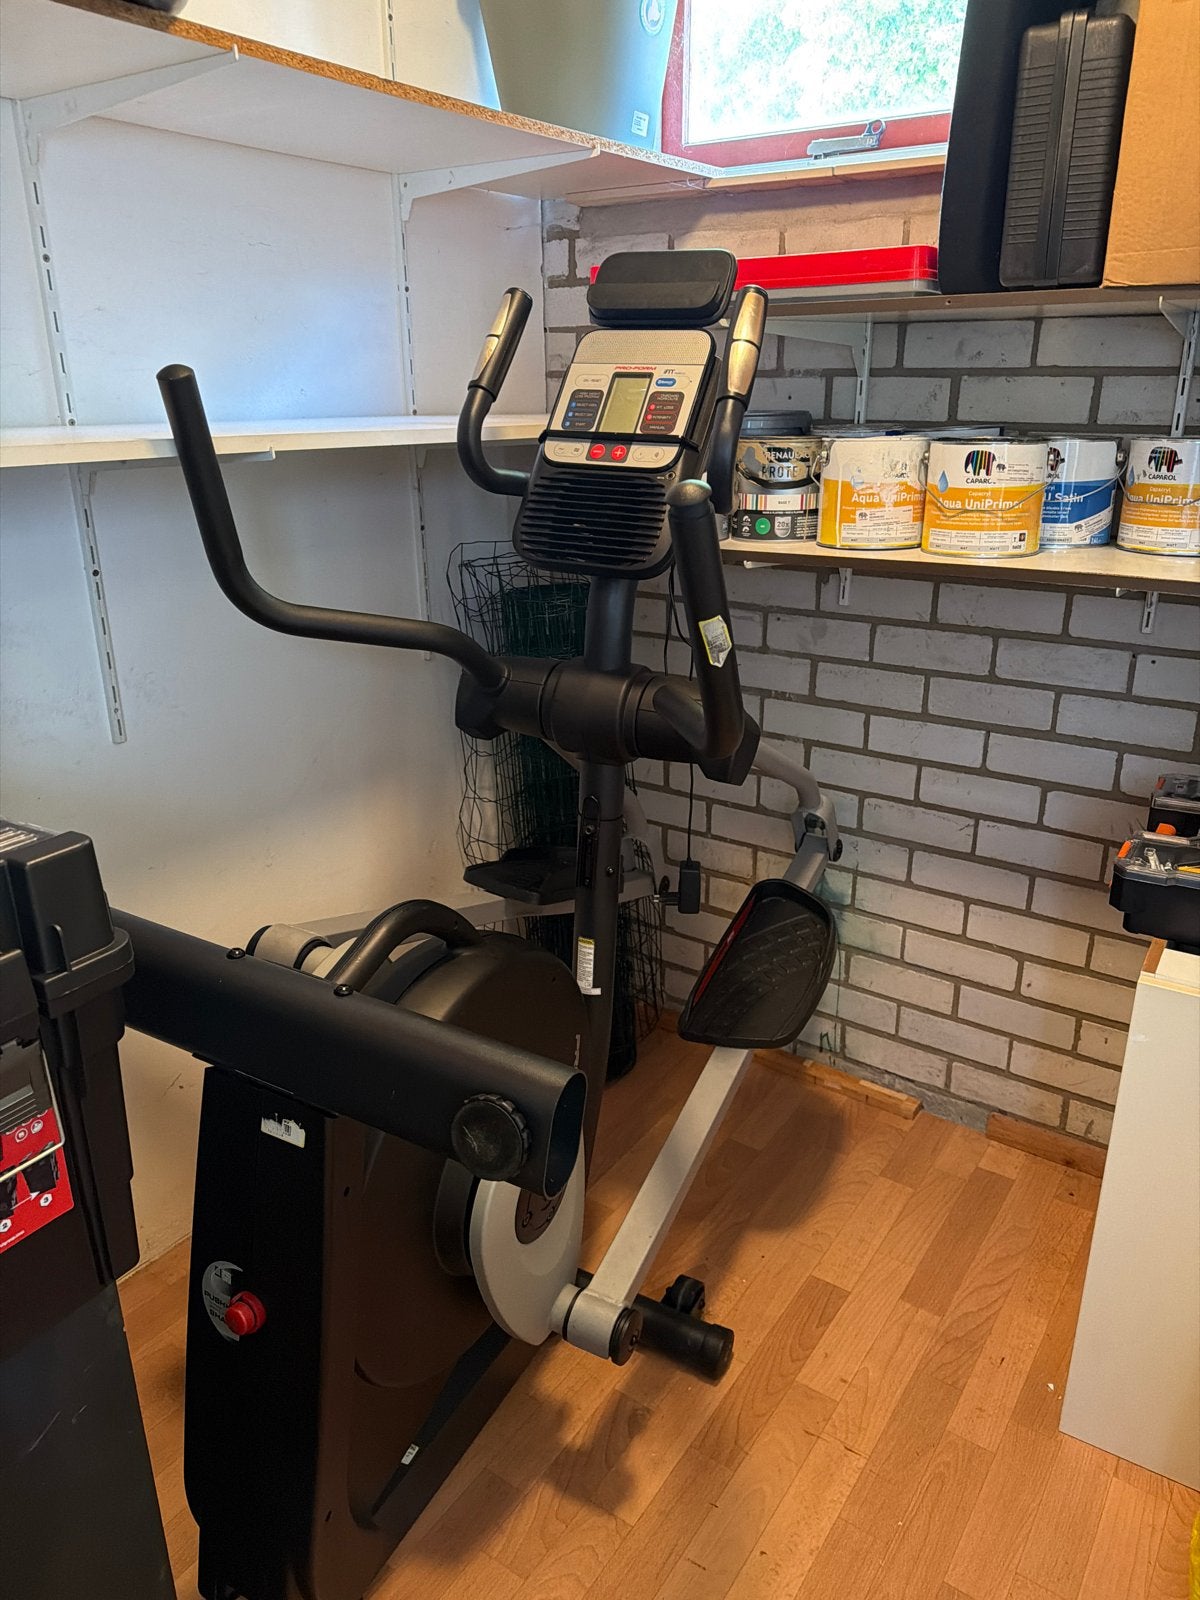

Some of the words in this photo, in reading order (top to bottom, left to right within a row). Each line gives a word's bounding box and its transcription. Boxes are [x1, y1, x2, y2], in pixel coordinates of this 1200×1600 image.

[761, 465, 812, 478] PROTET
[1148, 473, 1177, 481] CAPAROL
[852, 493, 880, 504] Aqua
[969, 490, 992, 498] Capacryl
[965, 498, 1024, 510] UniPrimer
